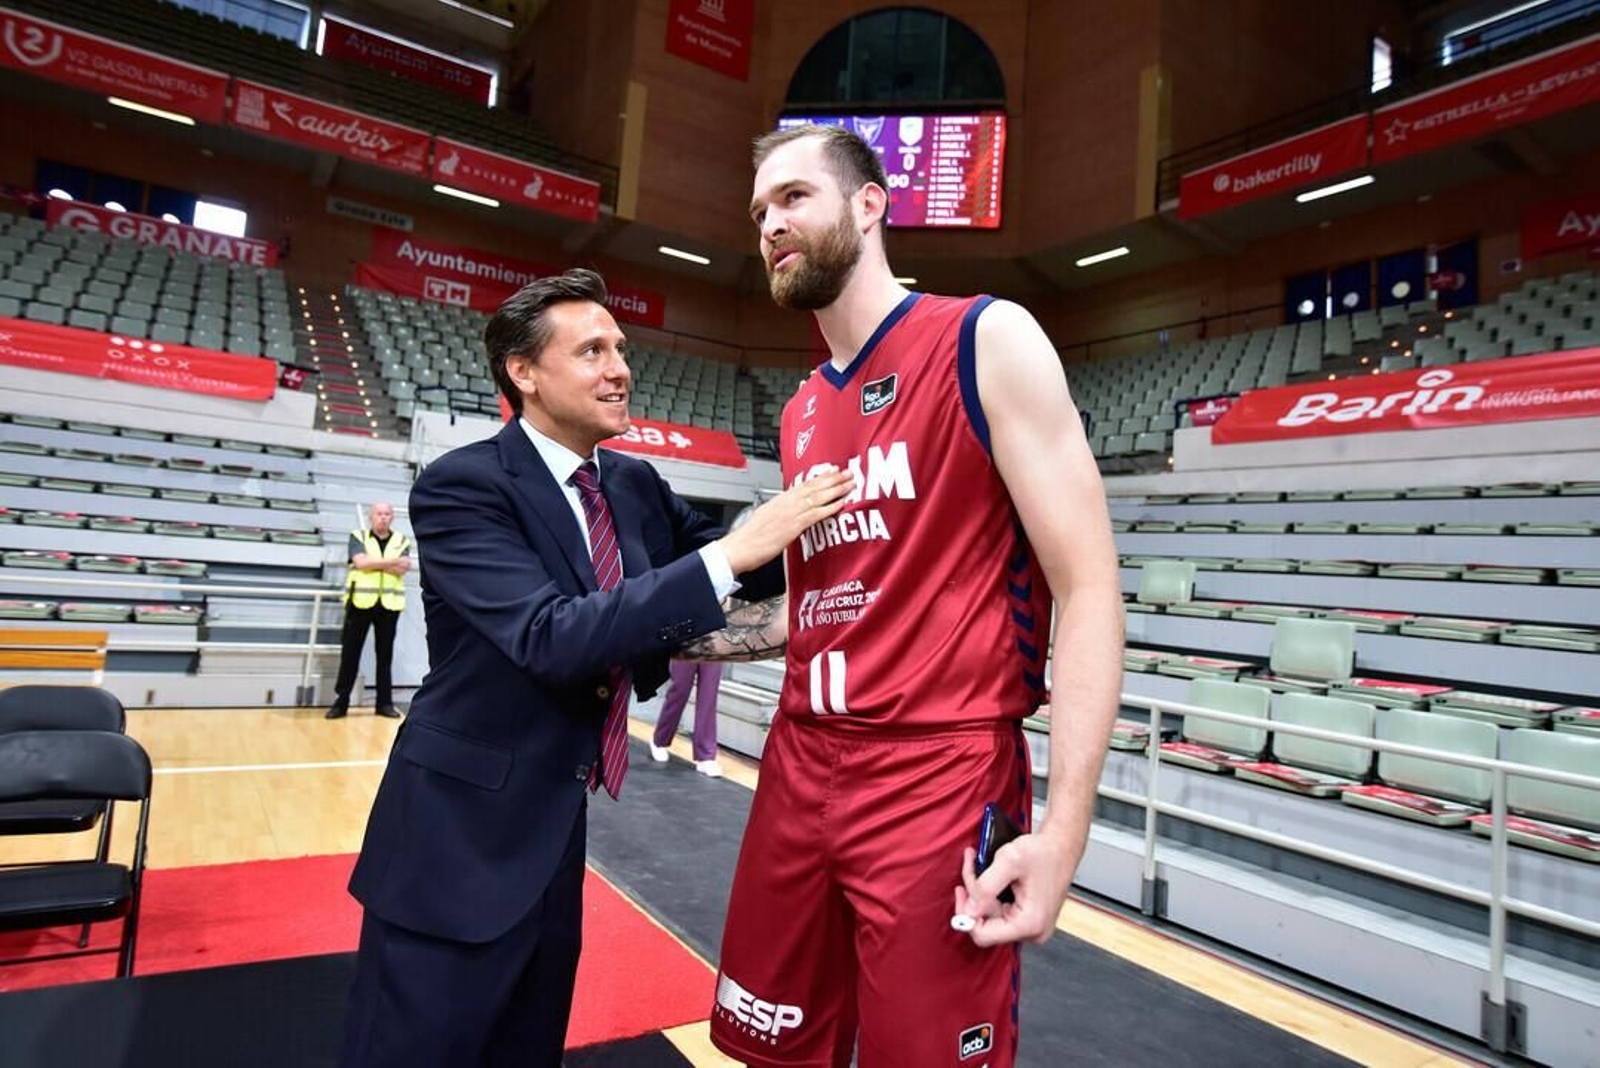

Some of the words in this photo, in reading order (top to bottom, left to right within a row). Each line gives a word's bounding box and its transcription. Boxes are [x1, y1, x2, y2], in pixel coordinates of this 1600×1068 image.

[1233, 152, 1322, 193] bakertilly
[110, 217, 267, 267] GRANATE
[397, 240, 537, 286] Ayuntamient
[810, 650, 850, 716] 11
[963, 1036, 984, 1055] acb
